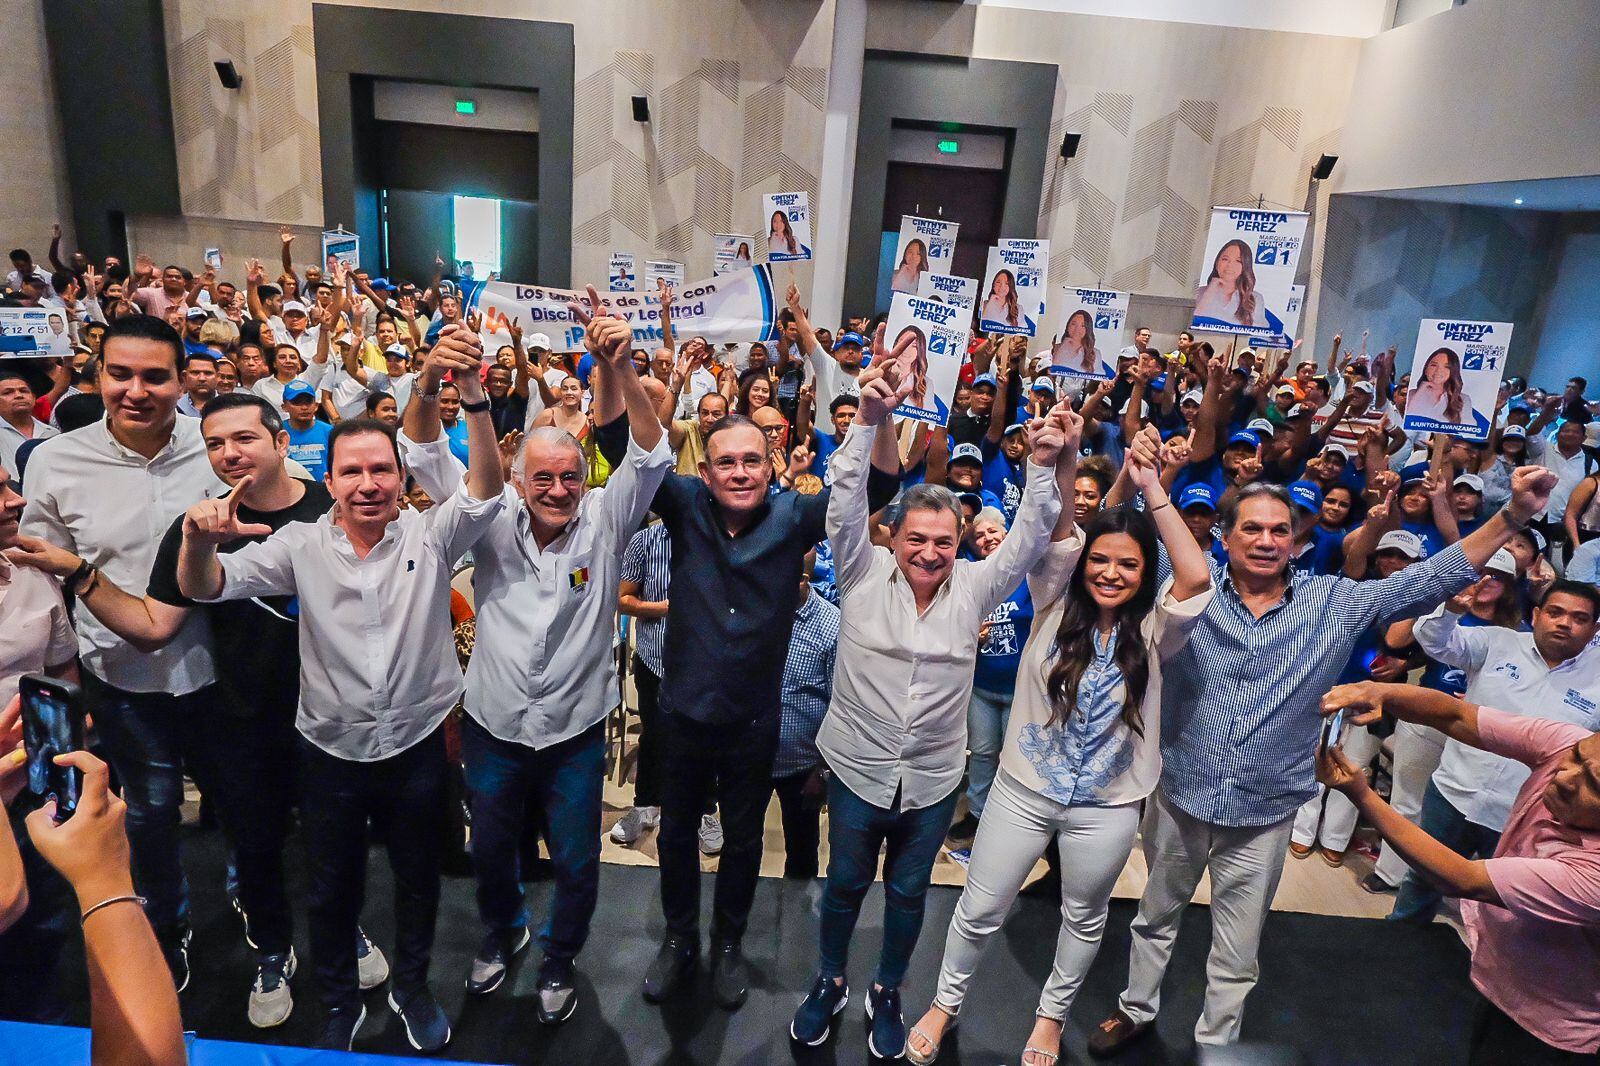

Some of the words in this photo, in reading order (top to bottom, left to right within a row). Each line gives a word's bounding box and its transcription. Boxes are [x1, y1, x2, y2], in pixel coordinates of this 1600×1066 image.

[1229, 210, 1288, 223] CINTHYA
[912, 219, 948, 230] CINTHYA
[1236, 221, 1278, 233] PEREZ
[916, 226, 942, 236] PEREZ
[943, 248, 949, 258] 1
[1000, 250, 1035, 260] CINTHYA
[1280, 250, 1290, 265] 1
[1004, 257, 1029, 266] PEREZ
[930, 275, 966, 287] CINTHYA
[1031, 277, 1038, 287] 1
[934, 283, 960, 293] PEREZ
[1076, 289, 1117, 299] CINTHYA
[516, 286, 544, 300] Los
[616, 296, 639, 307] de
[644, 294, 678, 305] Lus
[683, 284, 717, 299] con
[1081, 296, 1110, 306] PEREZ
[908, 298, 957, 318] CINTHYA
[913, 308, 949, 325] PEREZ
[1112, 319, 1118, 330] 1
[1437, 322, 1494, 334] CINTHYA
[1444, 331, 1485, 342] PEREZ
[949, 343, 957, 356] 1
[1487, 358, 1496, 370] 1
[905, 407, 942, 421] AVANZAMOS
[1410, 421, 1440, 429] #JUNTOS
[1440, 424, 1482, 433] AVANZAMOS
[999, 638, 1010, 654] 1
